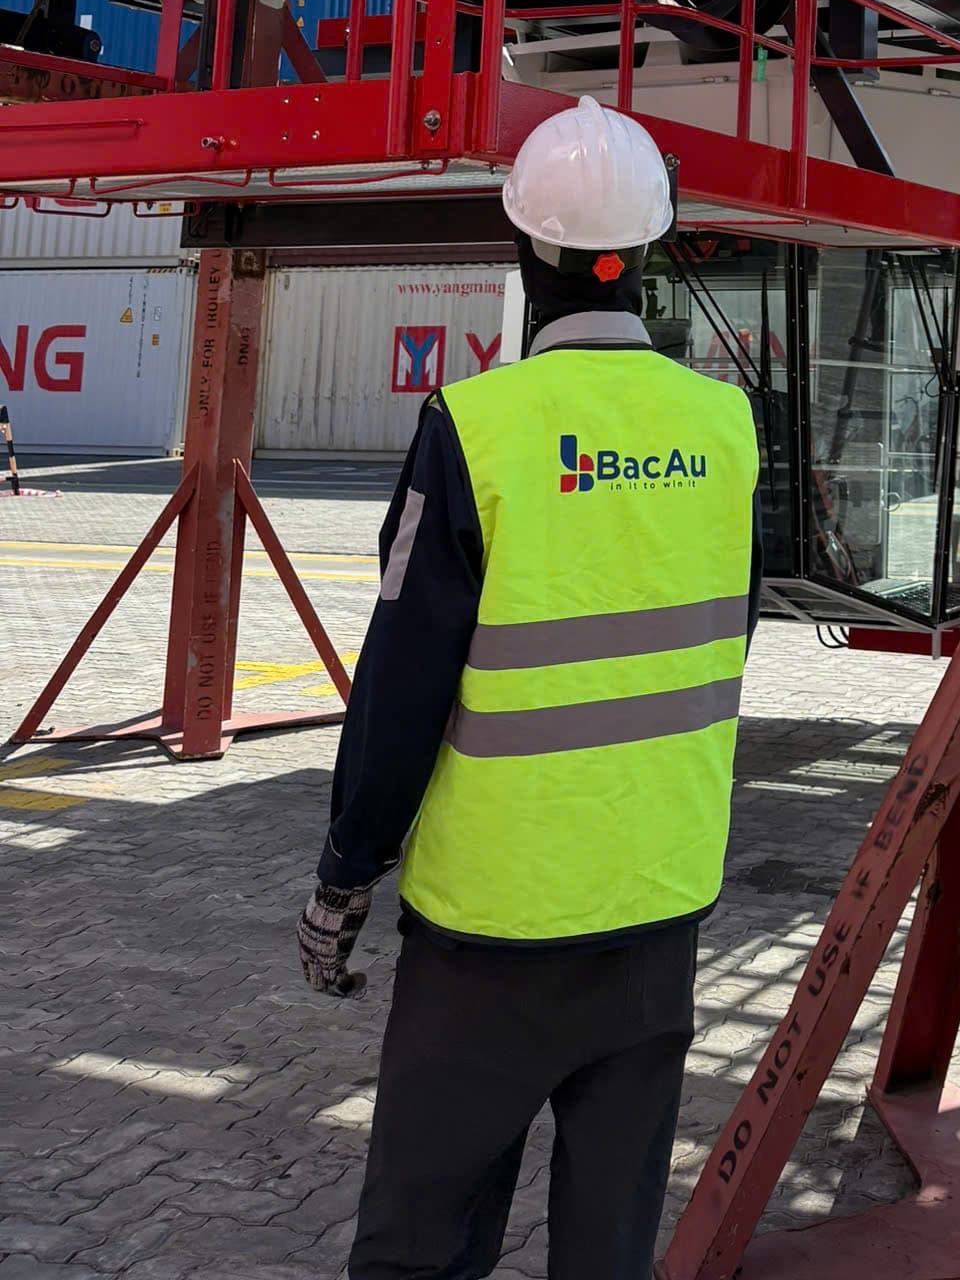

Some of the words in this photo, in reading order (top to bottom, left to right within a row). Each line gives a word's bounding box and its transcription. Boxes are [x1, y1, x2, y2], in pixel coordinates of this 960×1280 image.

[207, 267, 221, 328] TROLLEY
[203, 338, 216, 368] FOR
[199, 377, 212, 417] ONLY
[597, 449, 706, 480] BacAu
[610, 482, 622, 491] in
[644, 481, 656, 489] to
[663, 480, 683, 489] win
[201, 615, 218, 645] USE
[198, 655, 216, 687] NOT
[718, 1119, 751, 1184] DO
[757, 1010, 801, 1105] NOT
[808, 921, 849, 998] USE
